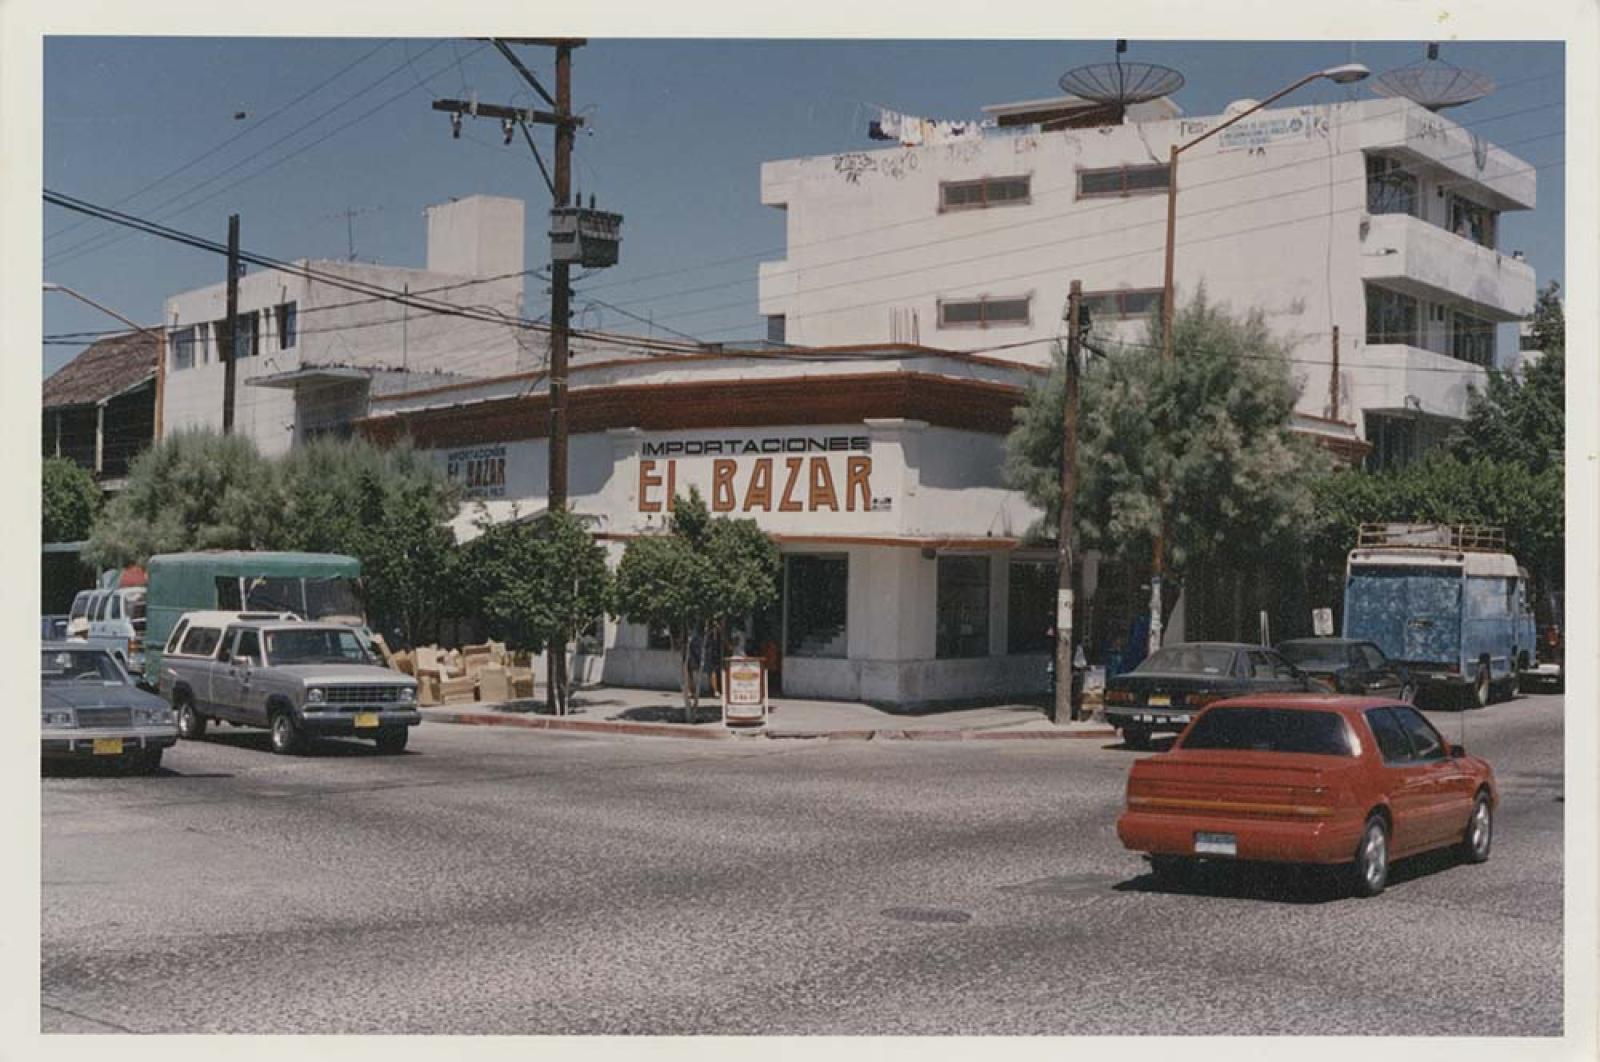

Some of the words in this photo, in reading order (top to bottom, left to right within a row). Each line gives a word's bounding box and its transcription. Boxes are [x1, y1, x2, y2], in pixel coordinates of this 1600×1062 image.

[642, 437, 870, 456] IMPORTACIONES
[467, 458, 506, 487] BAZAR
[712, 456, 873, 512] BAZAR
